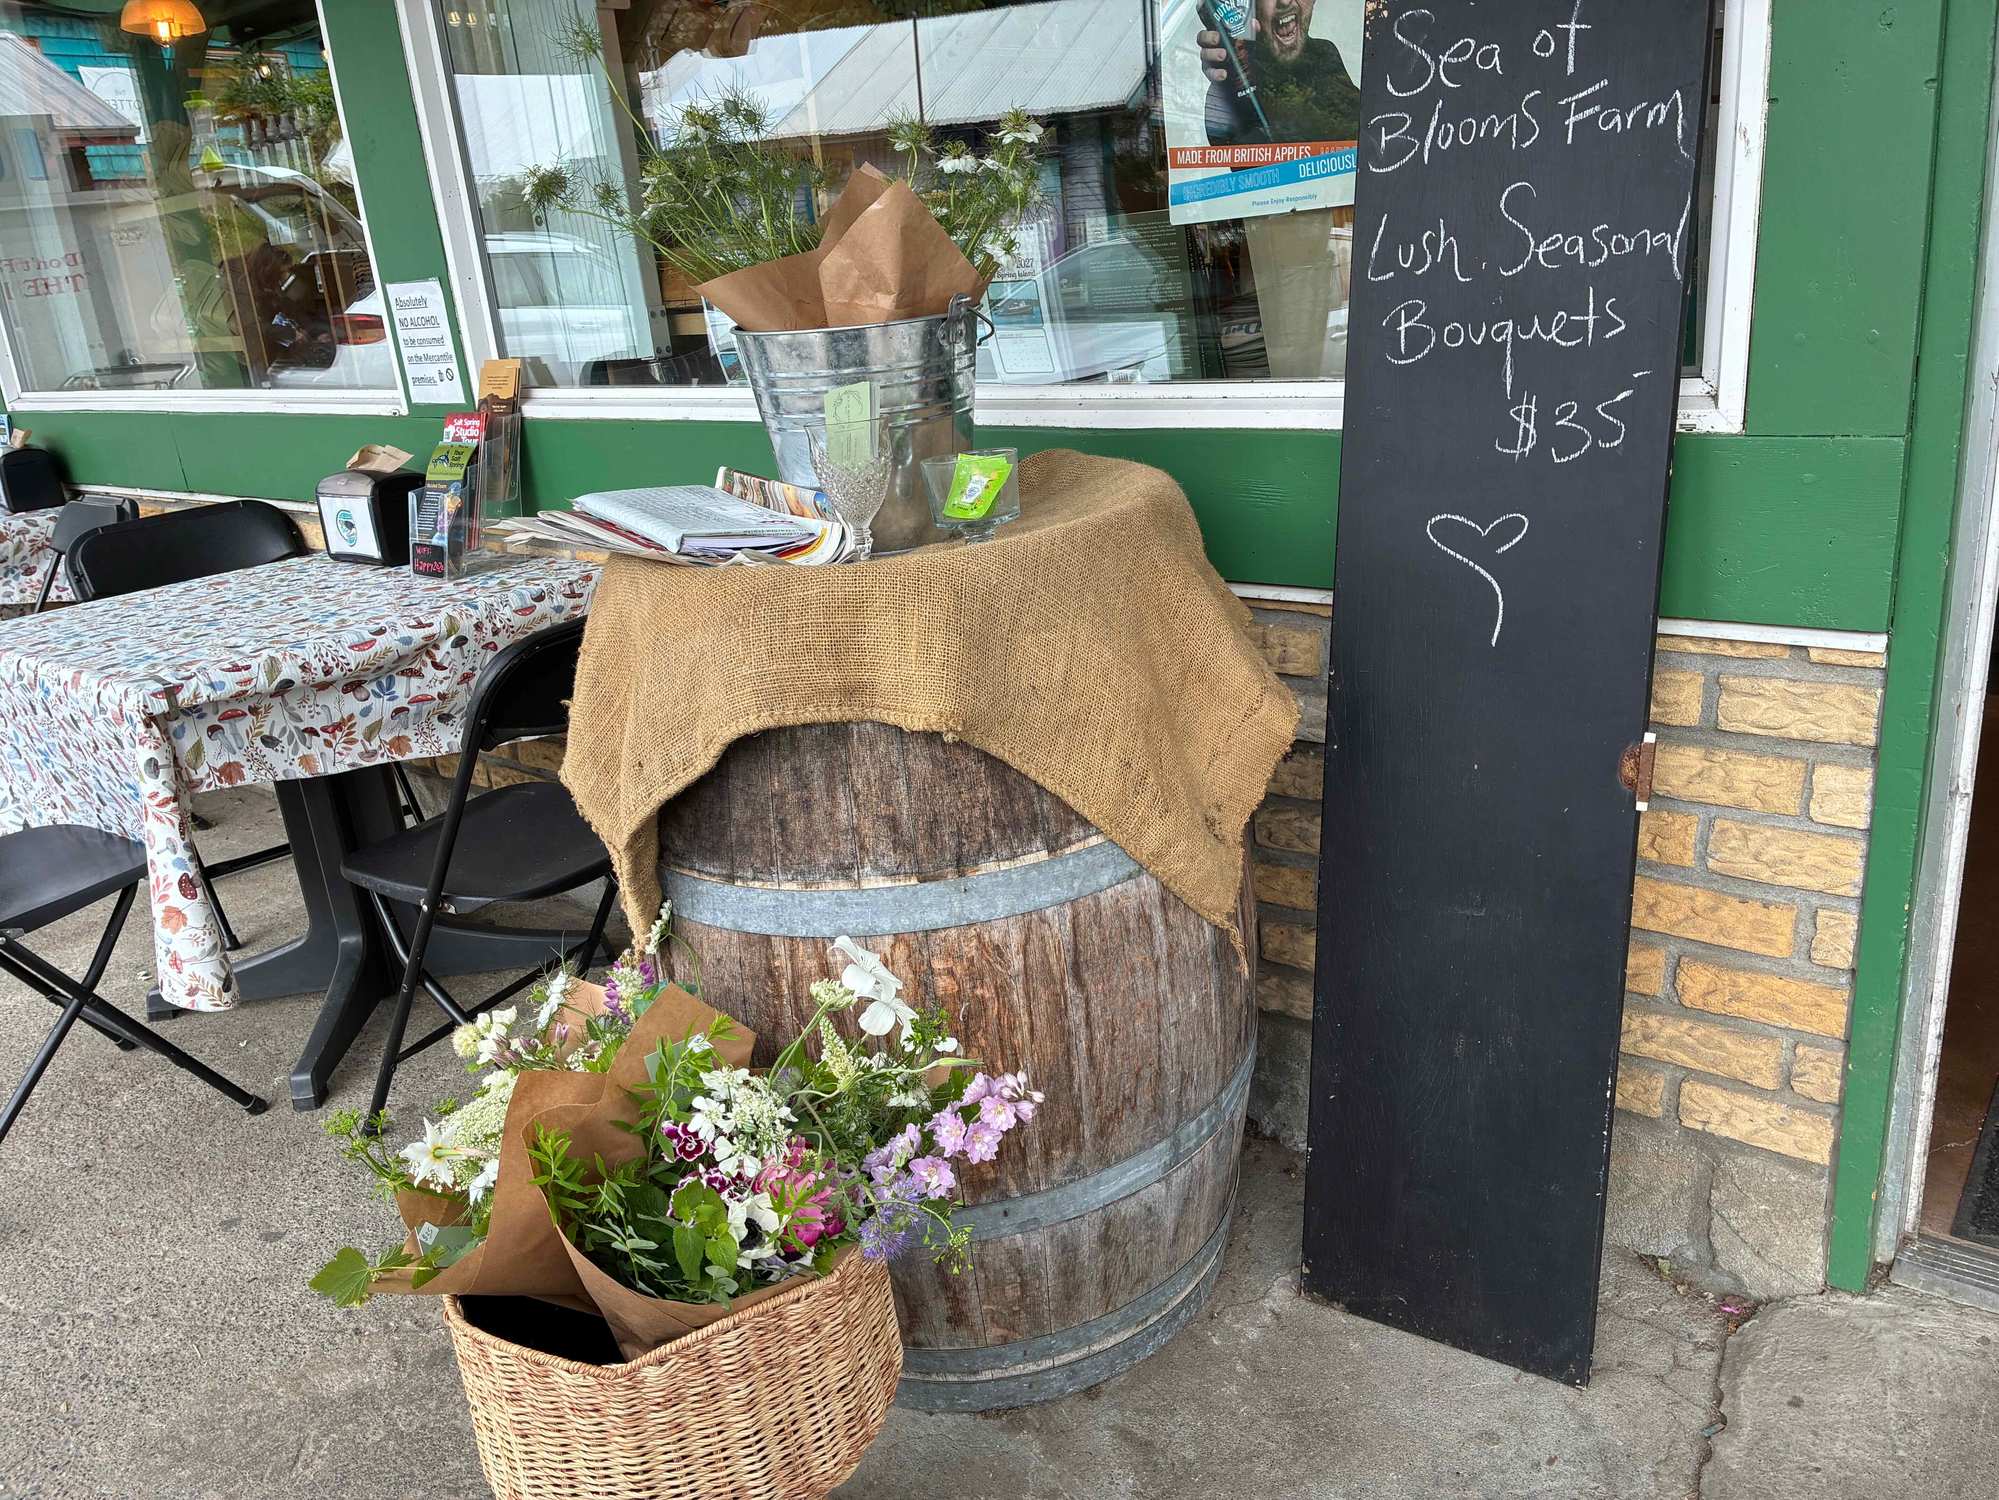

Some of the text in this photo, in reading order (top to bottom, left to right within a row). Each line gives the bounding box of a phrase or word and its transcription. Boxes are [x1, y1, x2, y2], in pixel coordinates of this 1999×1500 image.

[1387, 9, 1503, 97] Sea
[1368, 79, 1696, 173] Blooms Farm
[1177, 150, 1203, 165] MADE
[1205, 148, 1232, 164] FROM
[1234, 147, 1272, 162] BRITISH
[1274, 145, 1311, 161] APPLES
[1238, 168, 1280, 191] SMOOTH
[1500, 181, 1692, 281] Seasonal
[395, 295, 428, 309] Absolutely
[399, 315, 440, 328] NO ALCOHOL
[402, 335, 444, 346] to be consumed
[1382, 286, 1628, 400] Bouquets
[414, 353, 422, 362] the
[423, 352, 453, 362] Mercantile
[453, 418, 480, 428] Salt Spring
[455, 426, 479, 437] Studio
